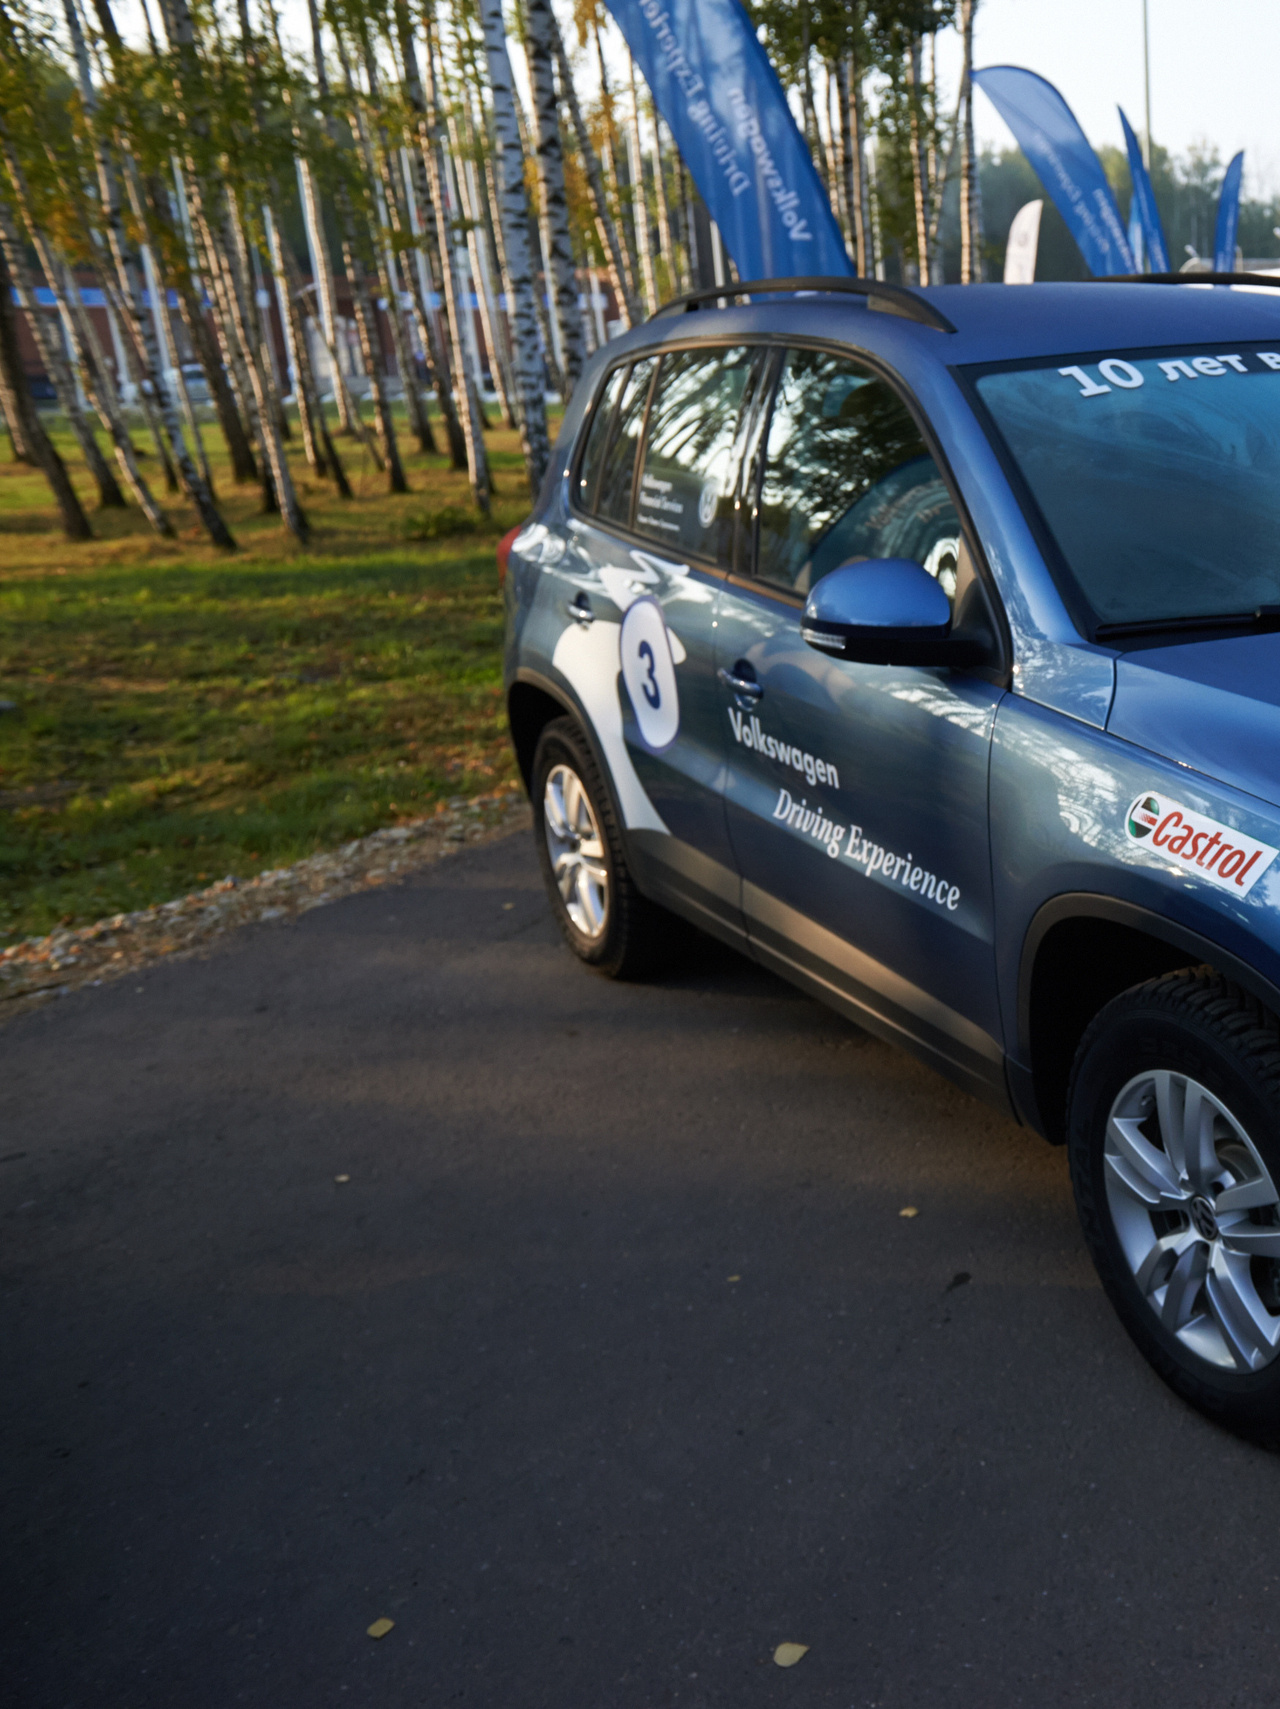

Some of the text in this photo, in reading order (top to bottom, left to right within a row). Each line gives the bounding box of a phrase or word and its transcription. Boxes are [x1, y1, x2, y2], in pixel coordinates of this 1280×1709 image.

[1058, 358, 1144, 398] 10
[1157, 354, 1250, 383] лет
[638, 640, 660, 710] 3
[728, 706, 840, 789] Volkswagen
[773, 788, 961, 911] Driving Experience
[1152, 811, 1263, 887] Castrol
